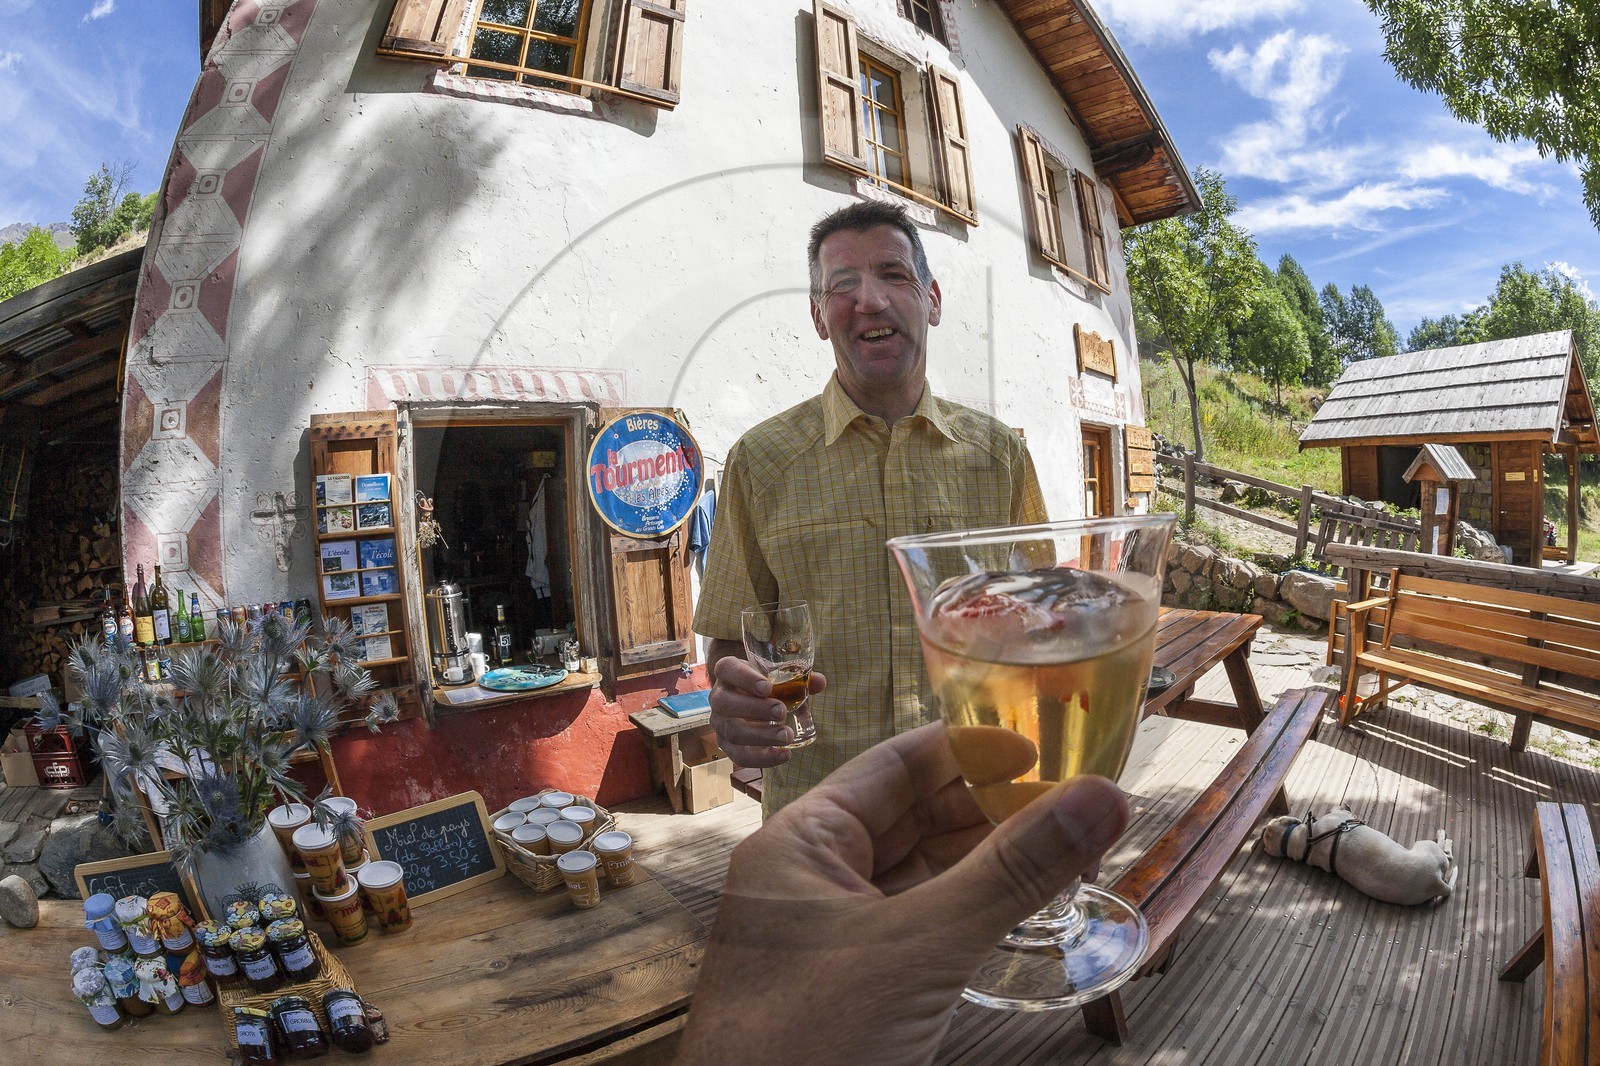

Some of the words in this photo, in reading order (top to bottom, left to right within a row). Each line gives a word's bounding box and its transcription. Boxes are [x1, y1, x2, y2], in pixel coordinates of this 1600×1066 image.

[625, 418, 659, 432] Bières
[590, 445, 697, 495] Tourmente
[327, 549, 350, 557] L'école
[371, 548, 393, 560] l'école
[384, 822, 417, 852] Miel
[420, 826, 439, 840] de
[439, 818, 471, 843] pays
